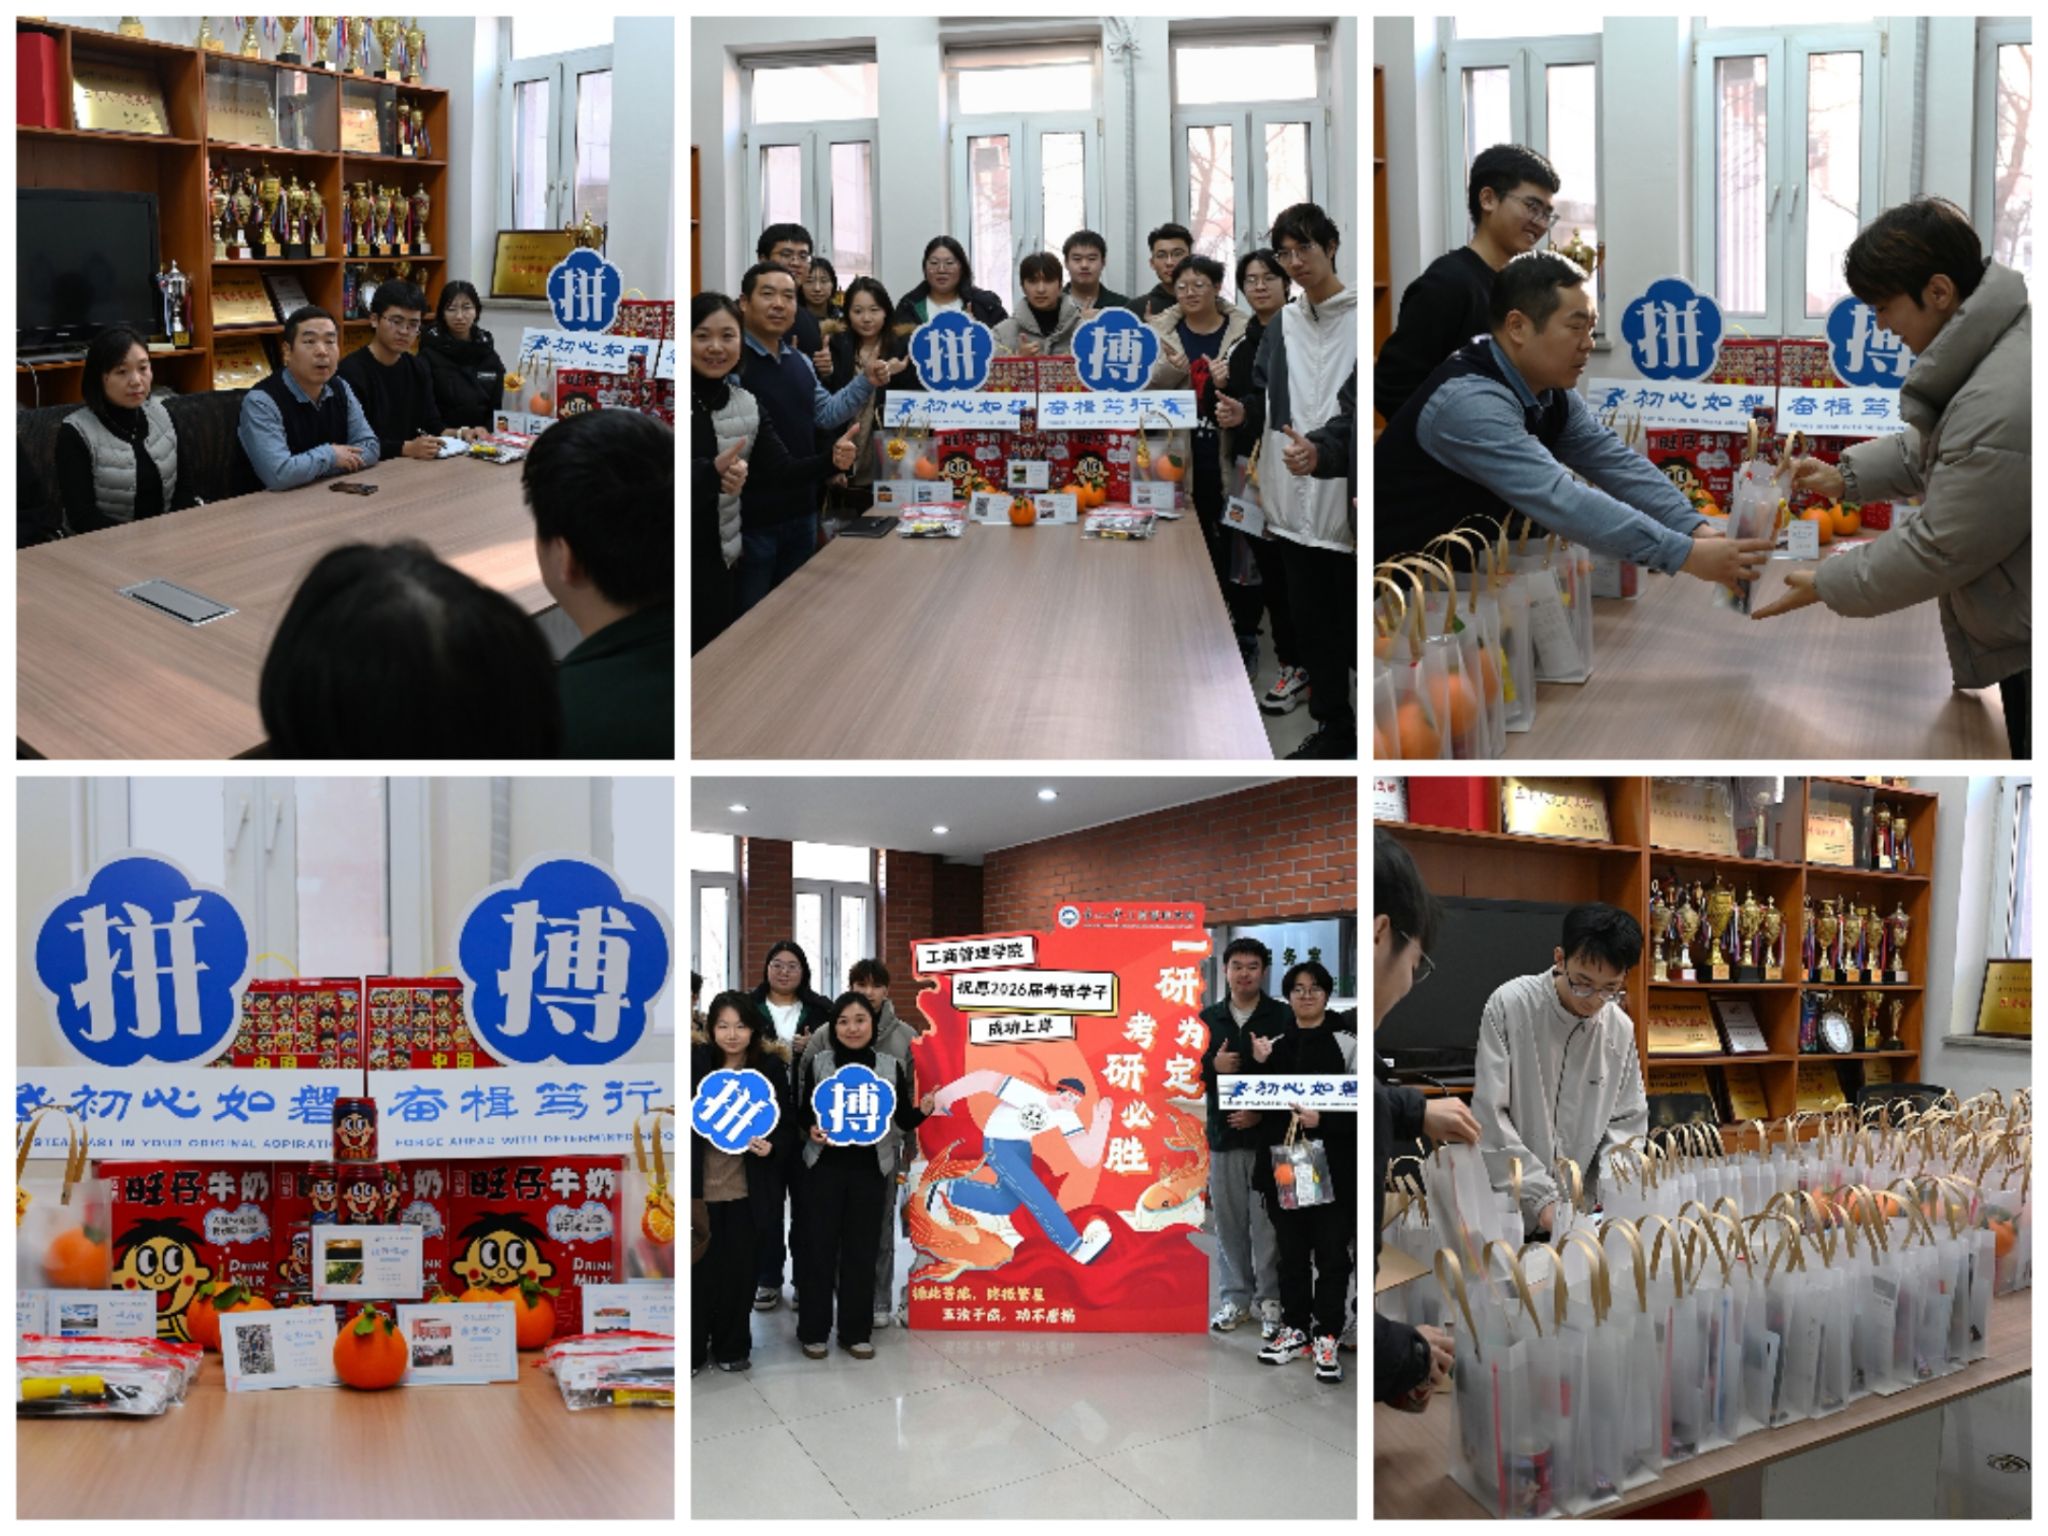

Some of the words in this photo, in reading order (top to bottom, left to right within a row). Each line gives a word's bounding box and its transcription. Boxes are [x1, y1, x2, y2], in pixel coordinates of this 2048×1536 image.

[558, 266, 606, 322] 拼
[924, 327, 976, 382] 拼
[1089, 327, 1143, 383] 搏
[1636, 299, 1703, 370] 拼
[1787, 395, 1902, 419] 奋楫笃
[65, 896, 210, 1042] 拼
[496, 900, 637, 1043] 搏
[926, 942, 1025, 964] 工商管理学院
[956, 980, 1108, 1000] 祝愿2026届考研学子
[988, 1018, 1053, 1036] 成功上岸
[1154, 939, 1208, 1095] 一研为定
[66, 1084, 341, 1124] 初心如磐
[387, 1080, 662, 1122] 奋楫笃行
[698, 1078, 768, 1143] 拼
[829, 1083, 881, 1134] 搏
[1101, 1009, 1158, 1173] 考研必胜
[121, 1139, 135, 1147] IN
[141, 1139, 182, 1147] YOUR
[263, 1139, 332, 1149] ASPIRATI
[501, 1135, 538, 1145] WITH
[126, 1170, 269, 1206] 旺仔牛奶
[468, 1167, 616, 1200] 旺仔牛奶
